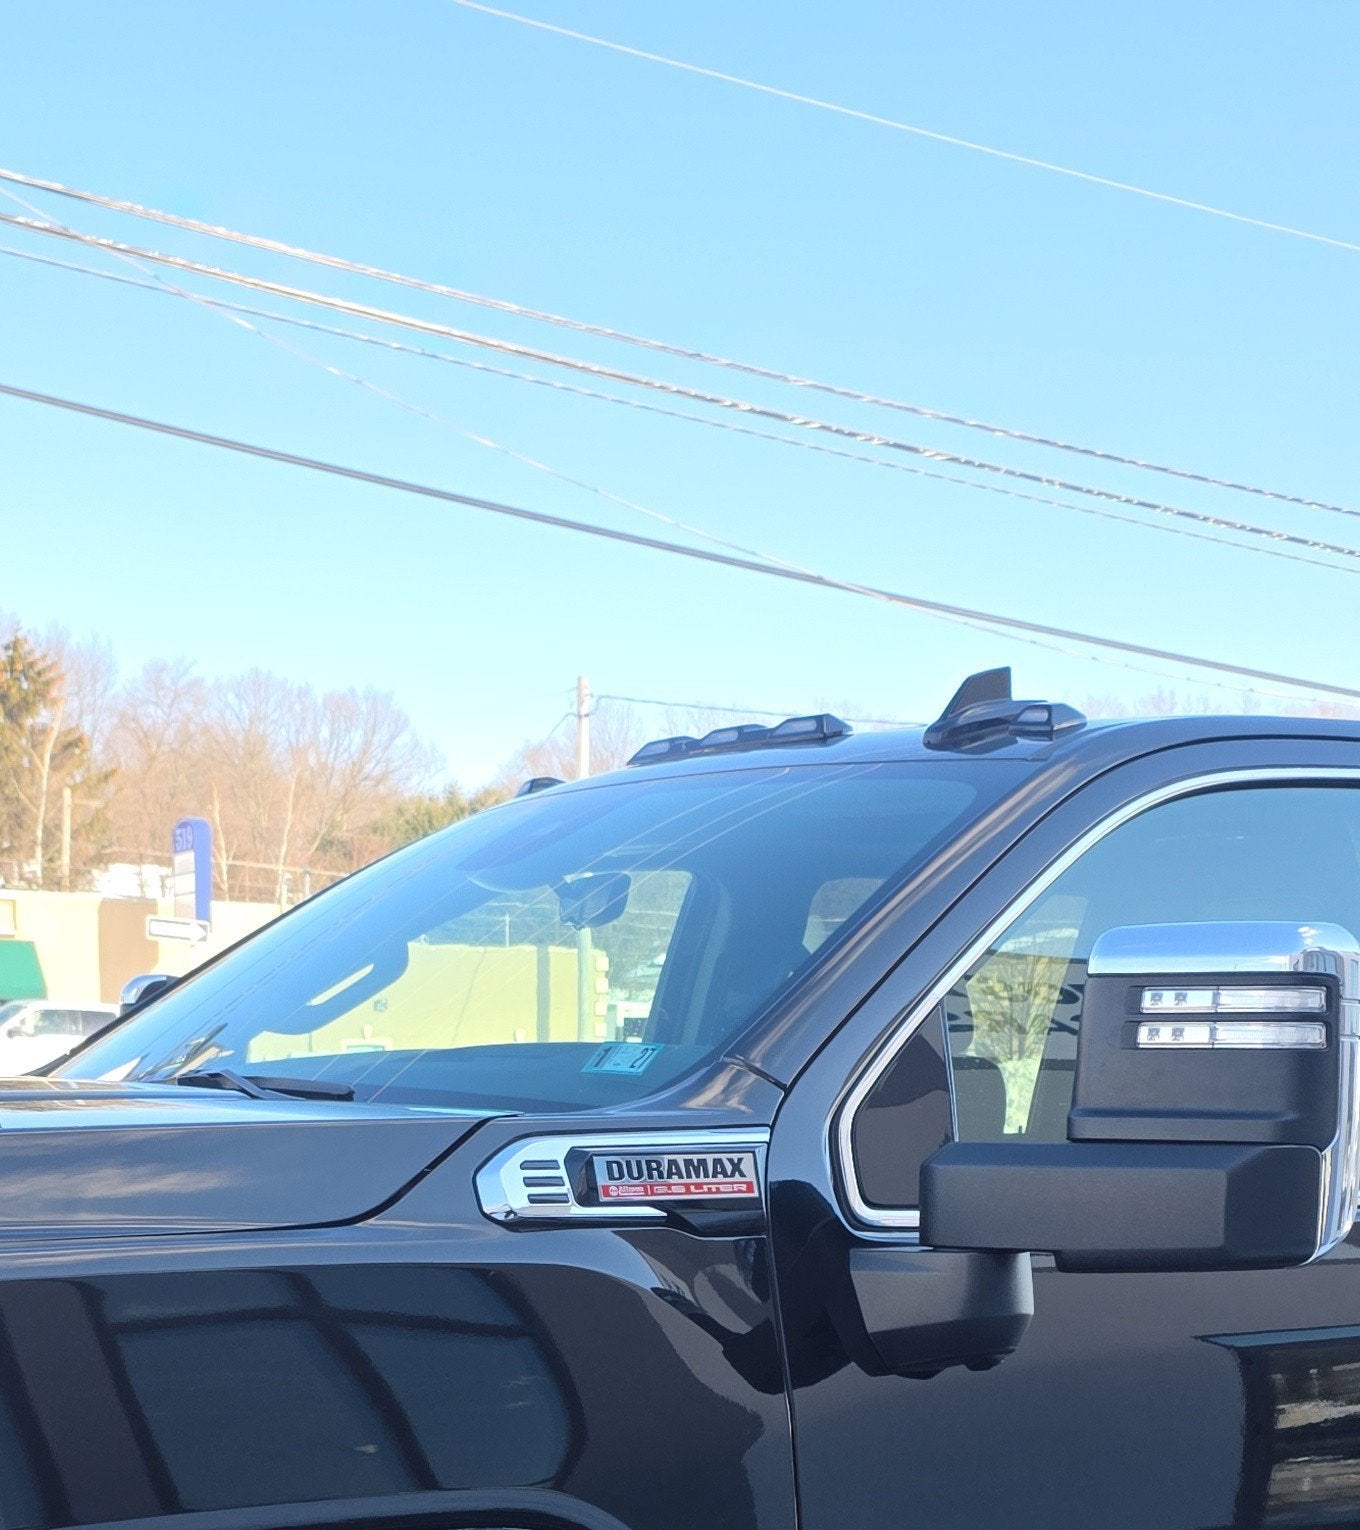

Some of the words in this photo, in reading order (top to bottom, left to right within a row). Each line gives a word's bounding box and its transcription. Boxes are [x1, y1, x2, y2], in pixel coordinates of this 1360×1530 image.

[629, 1047, 657, 1069] 27
[605, 1156, 748, 1182] DURAMAX
[690, 1183, 748, 1193] LITER
